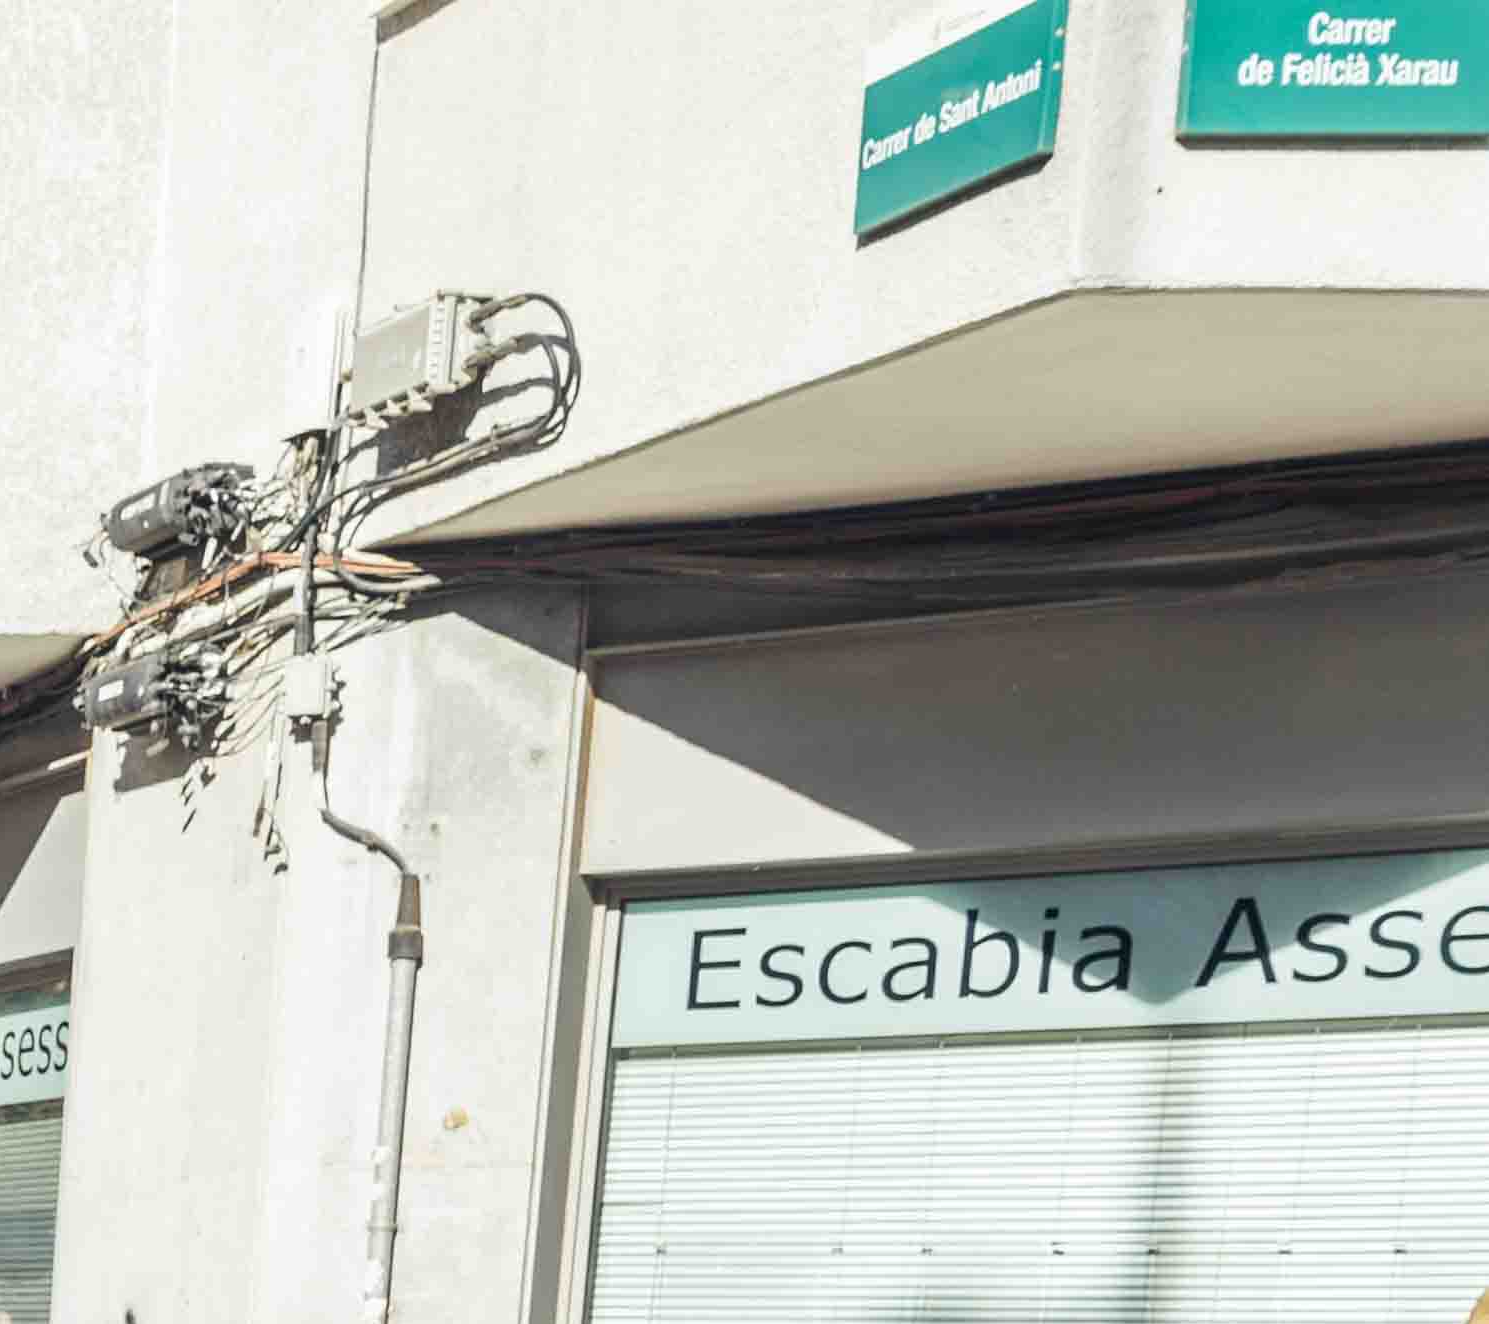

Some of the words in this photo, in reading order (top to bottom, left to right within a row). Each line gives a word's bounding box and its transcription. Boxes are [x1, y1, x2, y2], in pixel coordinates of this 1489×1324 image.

[1307, 10, 1397, 46] Carrer
[1237, 52, 1275, 86] de
[1281, 52, 1370, 87] Felicià
[1376, 52, 1459, 86] Xarau
[861, 125, 913, 171] Carrer
[913, 111, 937, 145] de
[937, 88, 981, 134] Sant
[980, 57, 1043, 114] Antoni
[684, 908, 1134, 1011] Escabia
